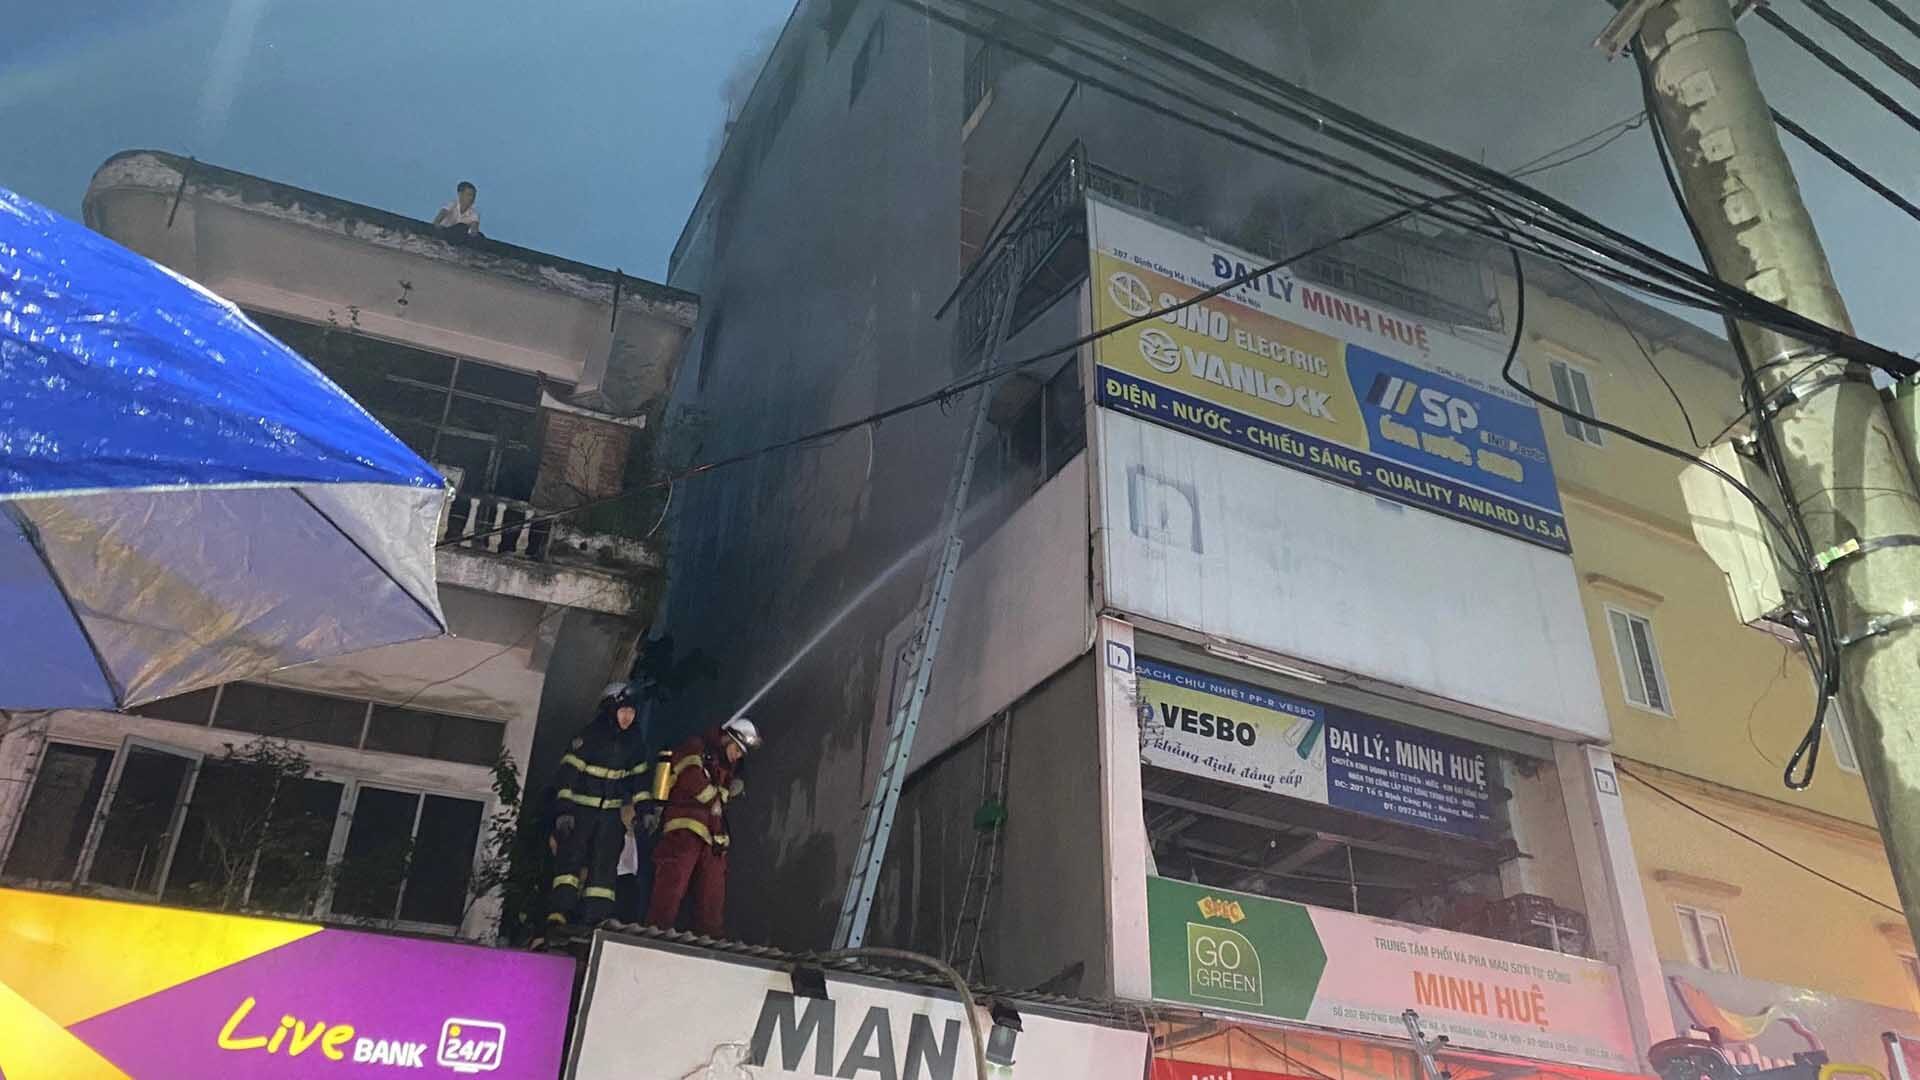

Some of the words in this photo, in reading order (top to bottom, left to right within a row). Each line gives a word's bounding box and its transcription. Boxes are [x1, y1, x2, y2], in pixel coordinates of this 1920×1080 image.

[1212, 253, 1260, 293] ĐẠI
[1267, 272, 1294, 303] LÝ
[1158, 292, 1230, 342] SINO
[1235, 328, 1329, 377] ELECTRIC
[1302, 287, 1372, 332] MINH
[1378, 314, 1431, 358] HUỆ
[1182, 345, 1337, 423] VANLOCK
[1420, 388, 1479, 434] SP
[1106, 377, 1157, 409] ĐIỆN
[1172, 400, 1232, 434] NƯỚC
[1247, 425, 1304, 457] CHIẾU
[1309, 446, 1362, 477] SÁNG
[1375, 466, 1452, 504] QUALITY
[1458, 493, 1520, 525] AWARD
[1522, 513, 1567, 541] U.S.A
[1160, 702, 1257, 747] VESBO
[1279, 702, 1316, 717] VESBO
[1153, 738, 1200, 763] khẳng
[1203, 755, 1237, 775] định
[1240, 765, 1275, 785] đẳng
[1279, 768, 1303, 788] cấp
[1329, 727, 1359, 757] ĐẠI
[1363, 733, 1391, 763] LÝ:
[1395, 740, 1445, 776] MINH
[1451, 754, 1487, 790] HUỆ
[1195, 936, 1241, 969] GO
[1375, 936, 1407, 953] TRUNG
[1196, 968, 1256, 993] GREEN
[1413, 970, 1488, 1016] MINH
[1494, 983, 1549, 1032] HUỆ
[217, 996, 355, 1061] Live
[353, 1037, 427, 1068] BANK
[446, 1037, 498, 1063] 24/7
[749, 989, 961, 1080] MAN
